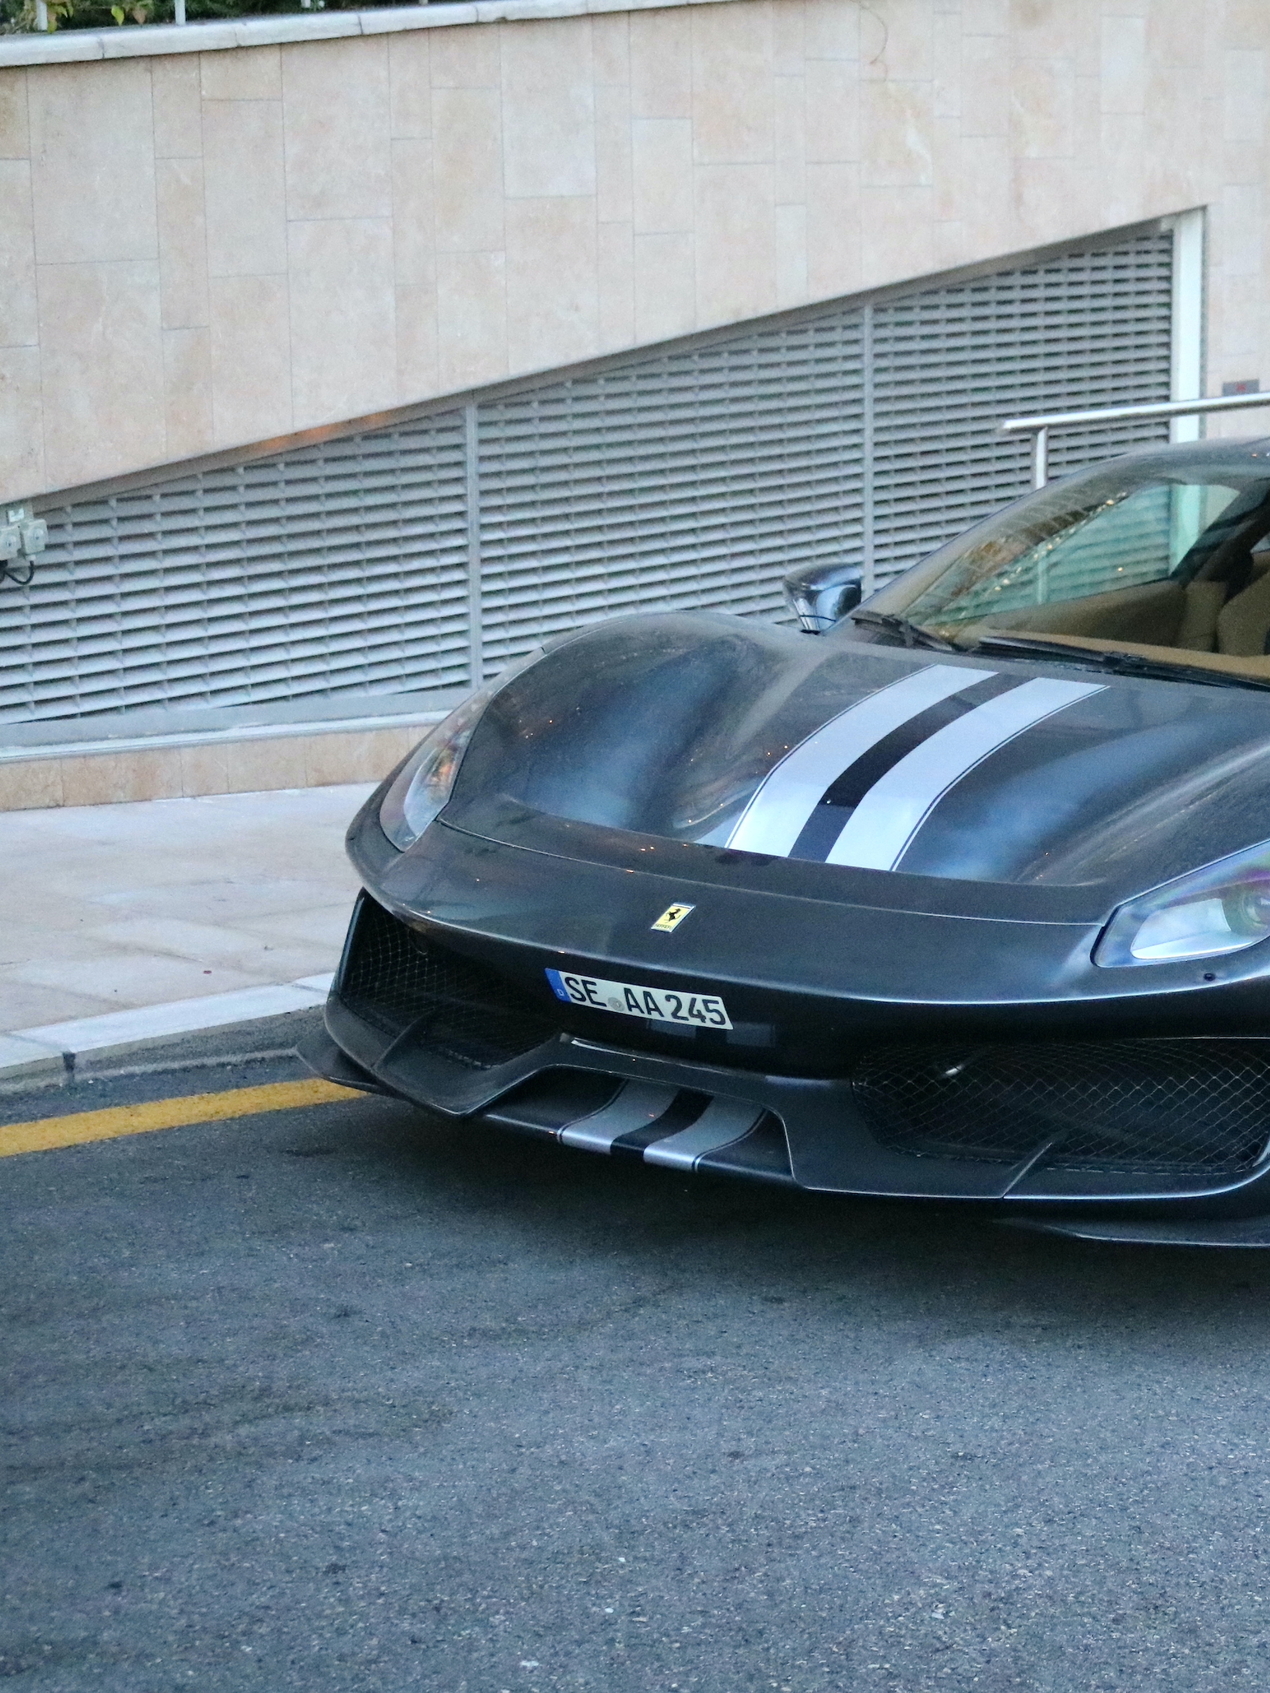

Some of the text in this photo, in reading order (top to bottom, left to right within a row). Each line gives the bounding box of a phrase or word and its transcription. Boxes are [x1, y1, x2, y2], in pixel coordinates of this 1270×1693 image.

[564, 976, 607, 1008] SE
[623, 987, 665, 1018] AA
[664, 994, 727, 1026] 245
